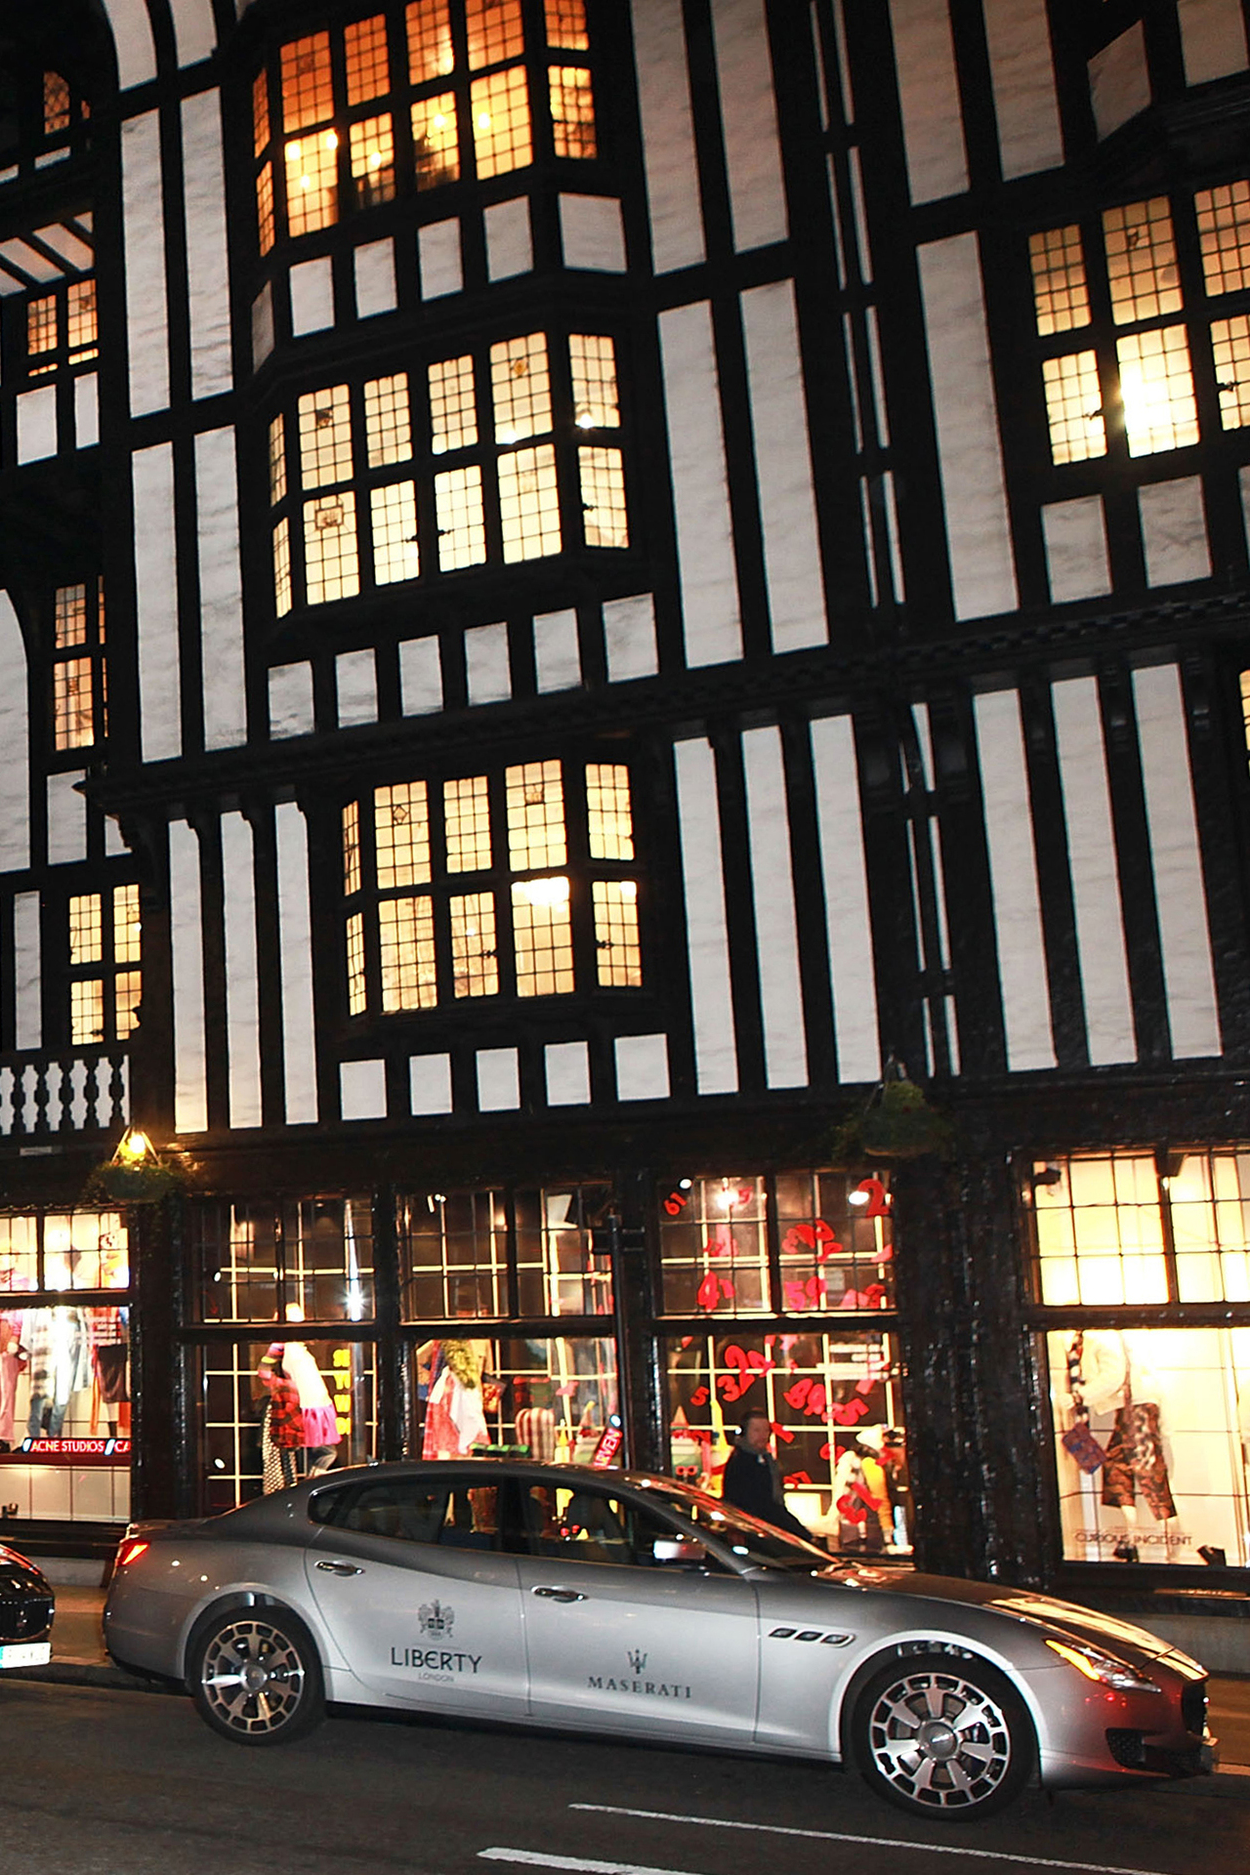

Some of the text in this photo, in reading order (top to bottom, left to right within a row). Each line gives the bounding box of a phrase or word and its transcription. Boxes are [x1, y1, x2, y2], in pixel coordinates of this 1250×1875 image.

[690, 1386, 711, 1407] 5
[30, 1440, 60, 1452] ACNE
[61, 1440, 106, 1452] STUDIOS
[1133, 1534, 1192, 1546] INCIDENT
[390, 1647, 483, 1674] LIBERTY
[417, 1672, 455, 1682] LONDON
[587, 1676, 692, 1698] MASERATI
